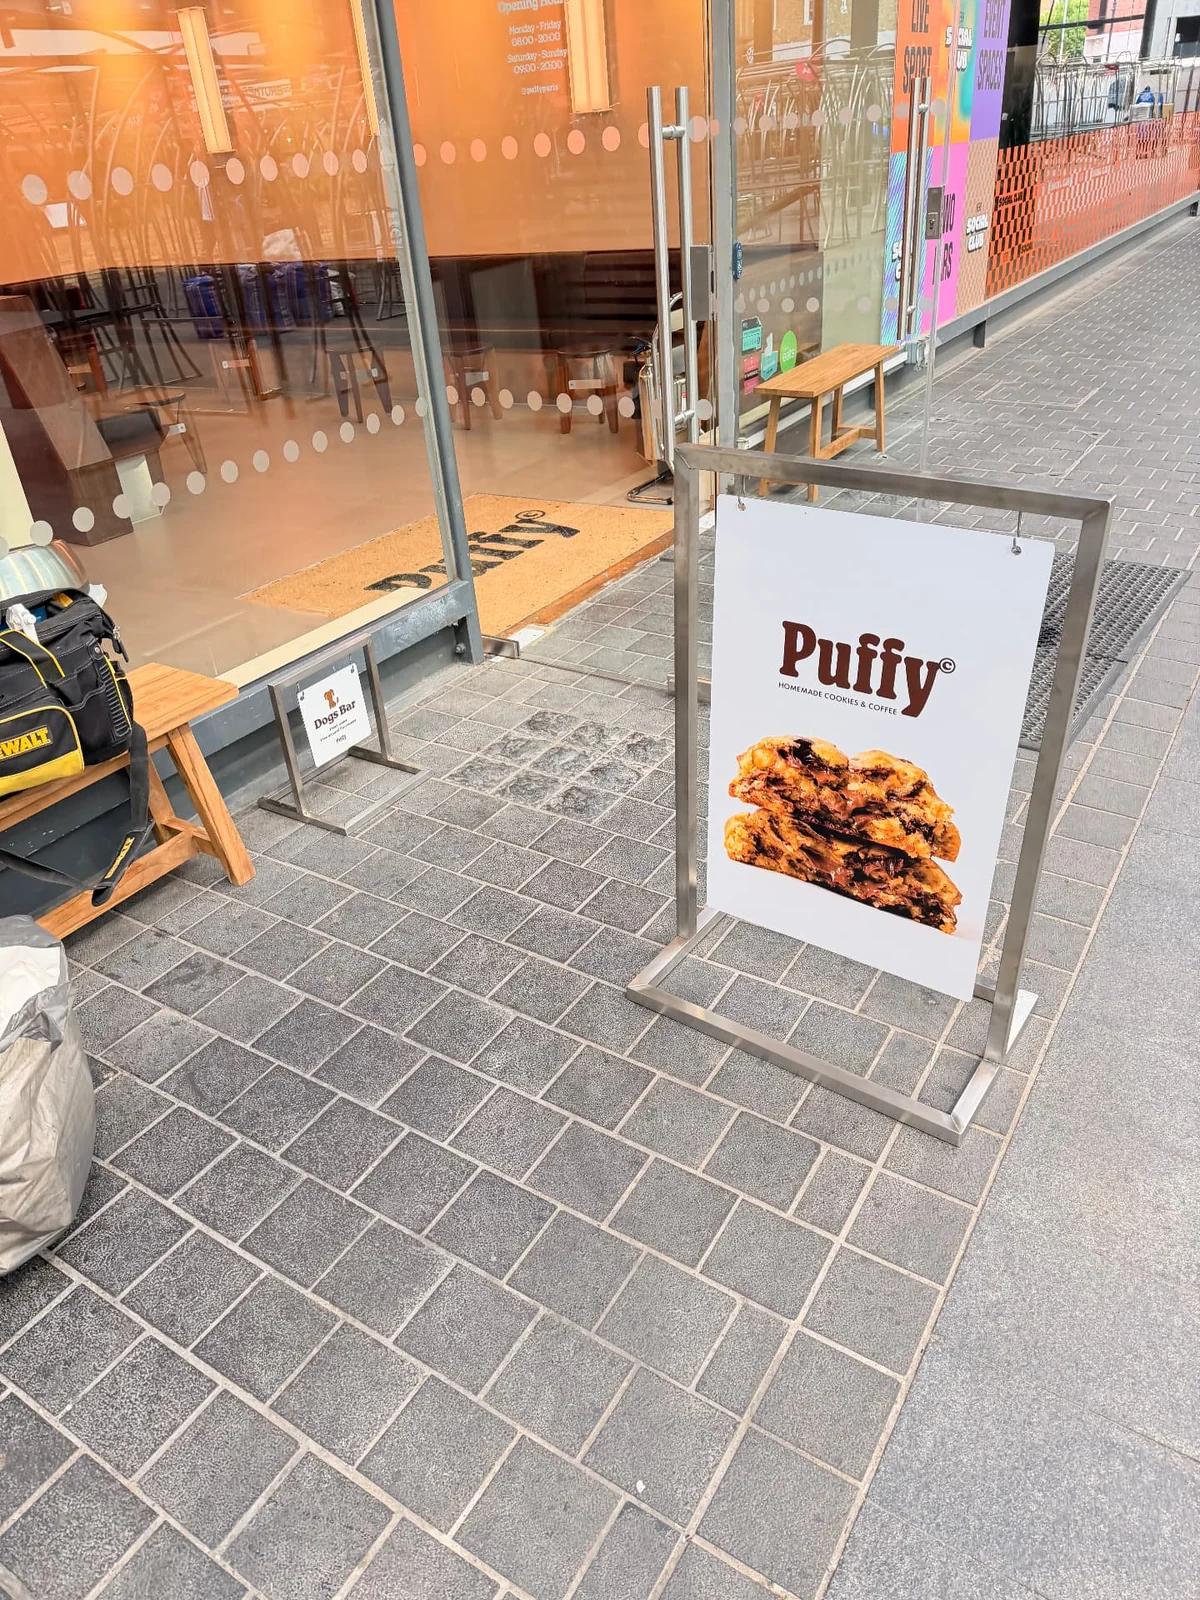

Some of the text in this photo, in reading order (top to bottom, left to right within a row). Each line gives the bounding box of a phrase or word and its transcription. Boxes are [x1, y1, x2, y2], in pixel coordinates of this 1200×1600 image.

[509, 25, 535, 35] Monday
[540, 20, 561, 31] Friday
[512, 36, 534, 46] 08:00
[541, 48, 567, 59] Sunday
[514, 63, 536, 74] 09:00
[778, 682, 898, 716] HOMEMADE COOKIES & COFFEE
[313, 710, 339, 730] Dogs
[339, 700, 357, 716] Bar
[0, 727, 49, 759] WALT
